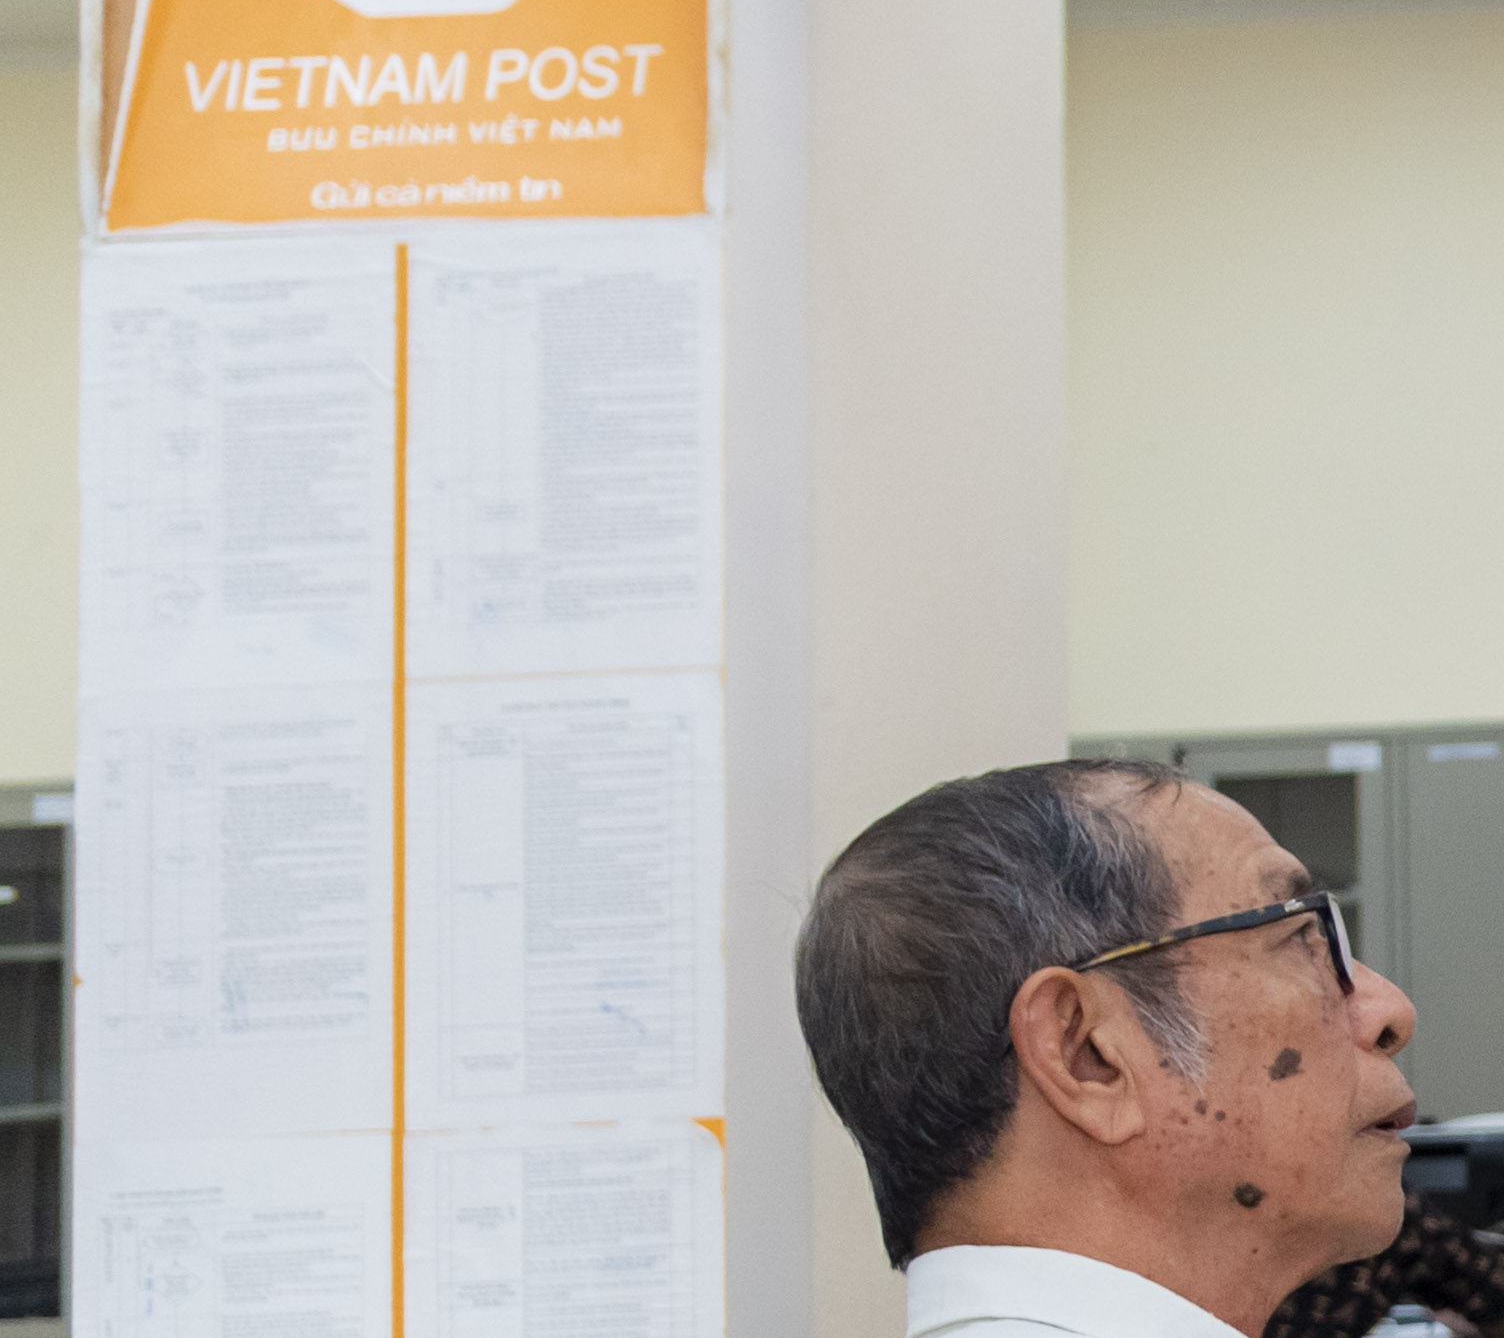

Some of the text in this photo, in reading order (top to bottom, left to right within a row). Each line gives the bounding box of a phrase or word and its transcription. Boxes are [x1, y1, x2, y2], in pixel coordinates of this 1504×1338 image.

[184, 43, 665, 112] VIETNAM POST
[348, 117, 458, 149] CHÍNH
[467, 111, 540, 146] VIỆT
[548, 117, 622, 141] NAM
[518, 176, 562, 202] tin
